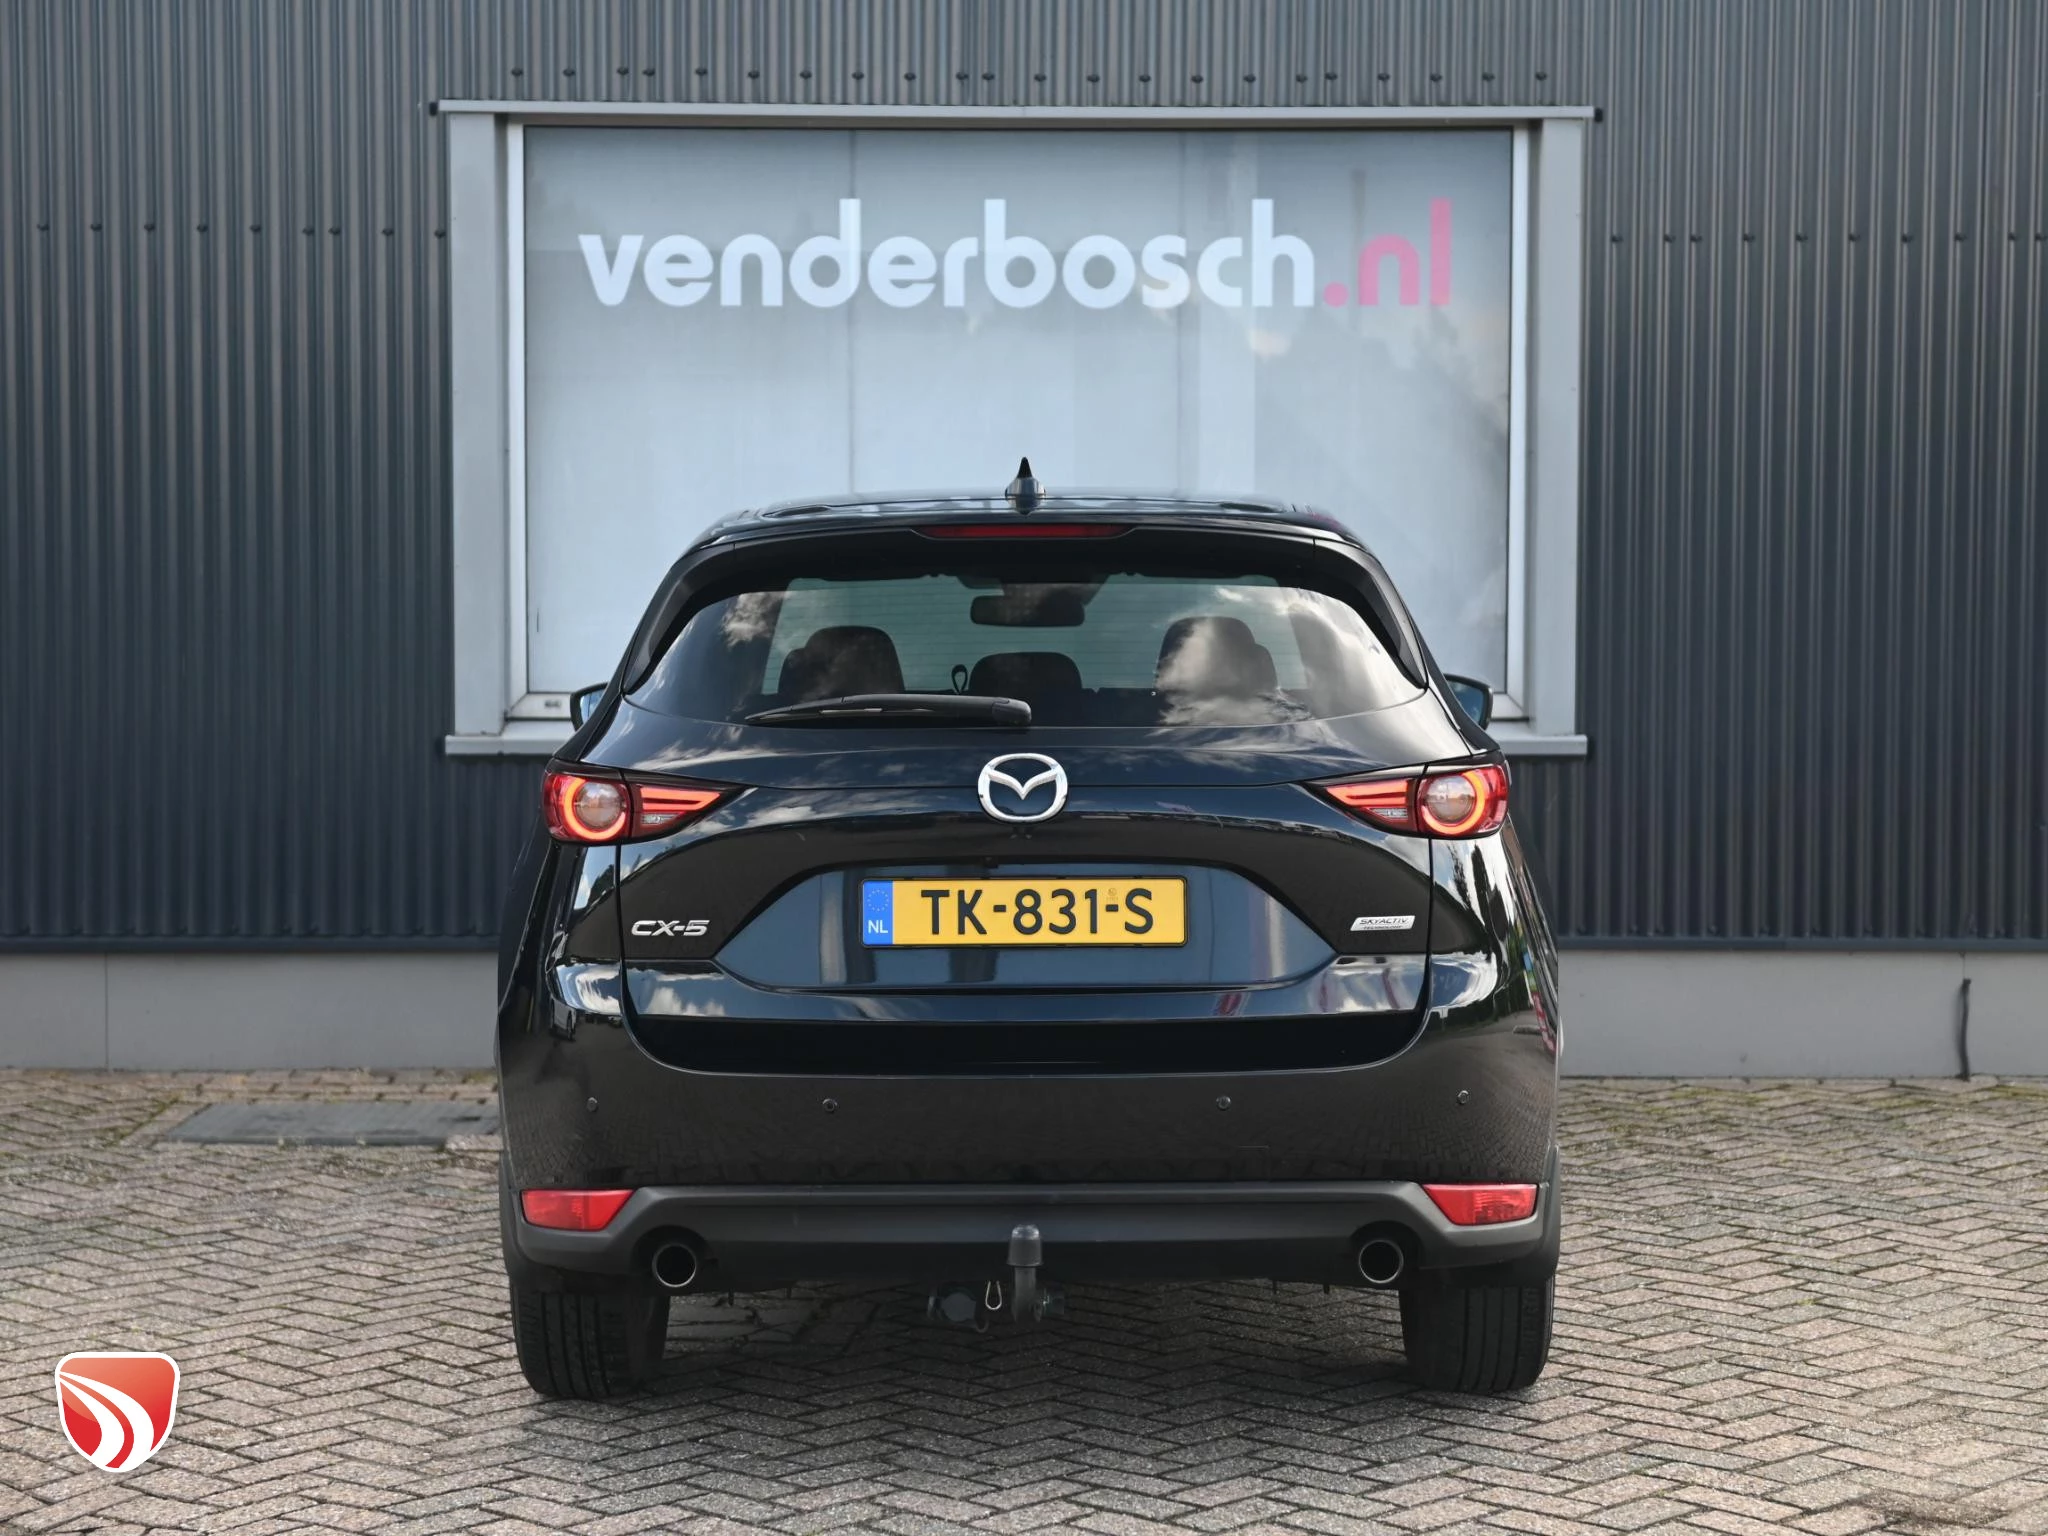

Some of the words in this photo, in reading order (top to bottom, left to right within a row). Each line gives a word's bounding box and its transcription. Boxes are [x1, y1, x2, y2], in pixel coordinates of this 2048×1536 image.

[578, 198, 1452, 309] venderbosch.nl
[921, 888, 1154, 935] TK-831-S
[631, 919, 710, 936] CX-5
[868, 919, 888, 934] NL
[1359, 917, 1409, 925] SKYACTIV
